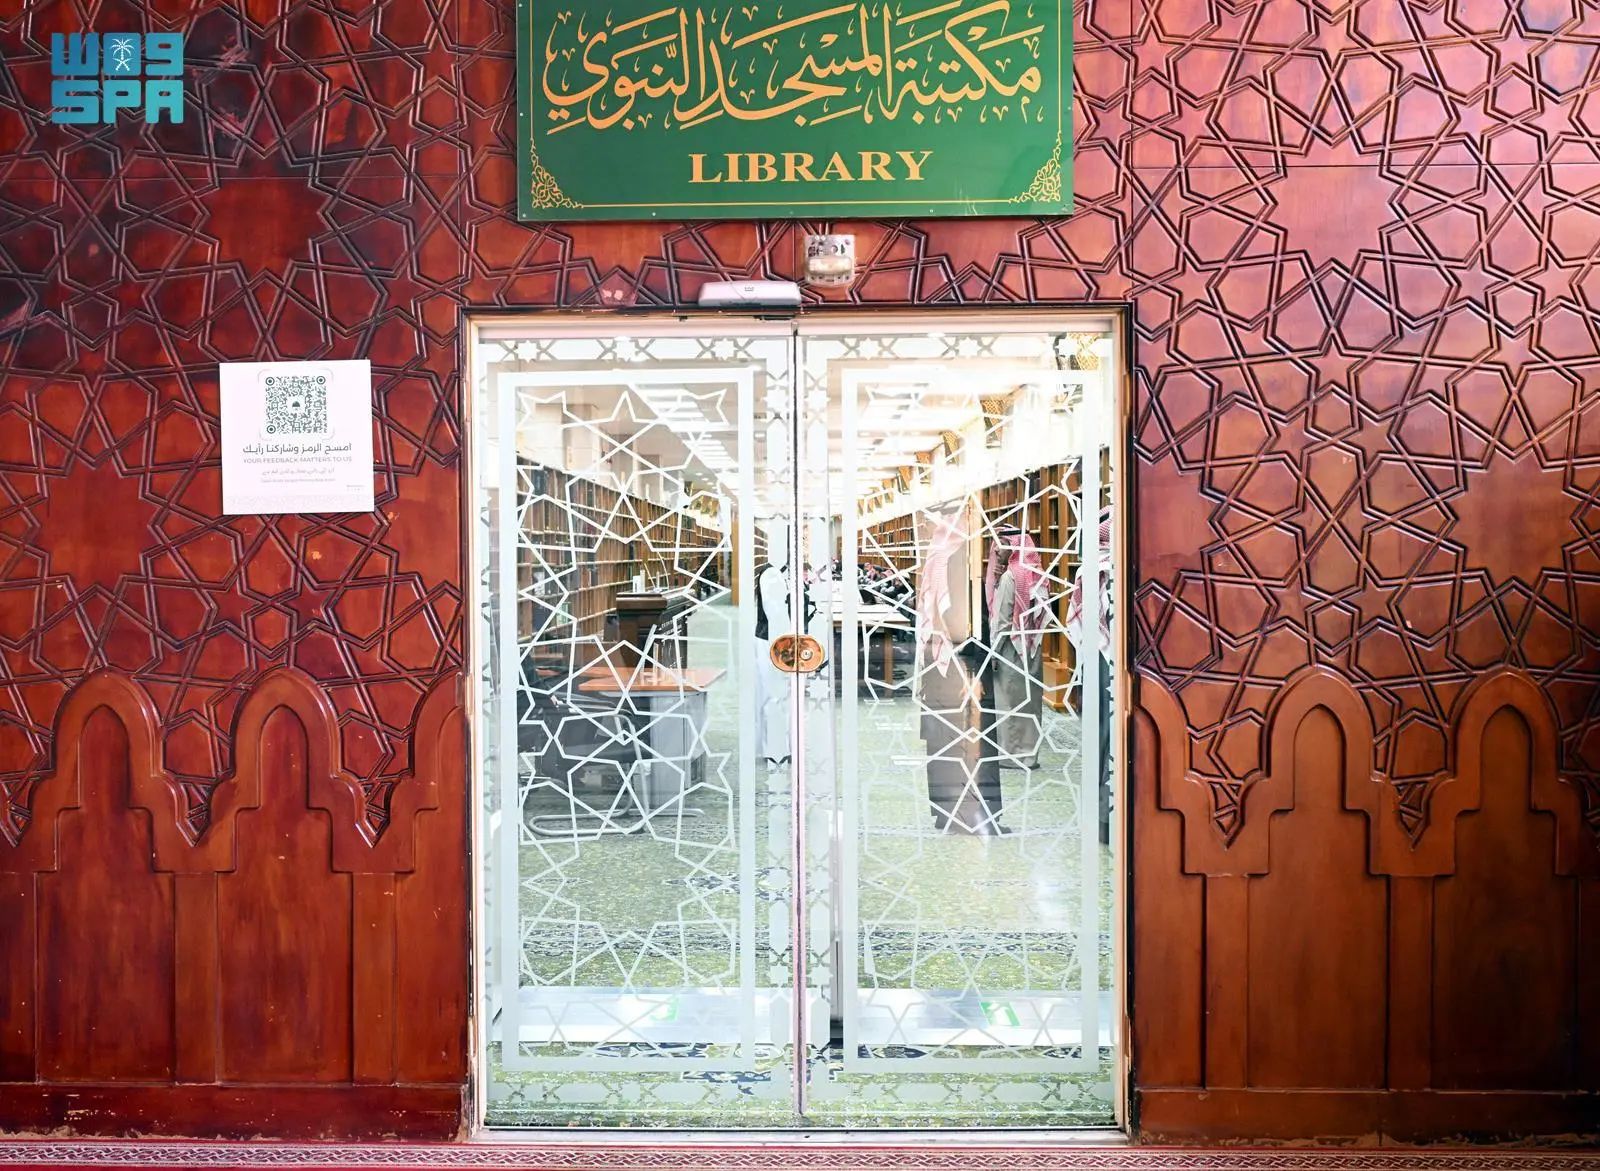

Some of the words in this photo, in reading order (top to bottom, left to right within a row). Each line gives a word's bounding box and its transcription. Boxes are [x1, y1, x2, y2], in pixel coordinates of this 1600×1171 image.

[688, 150, 934, 184] LIBRARY
[266, 443, 299, 455] وشاركنا
[301, 443, 322, 454] الرمز
